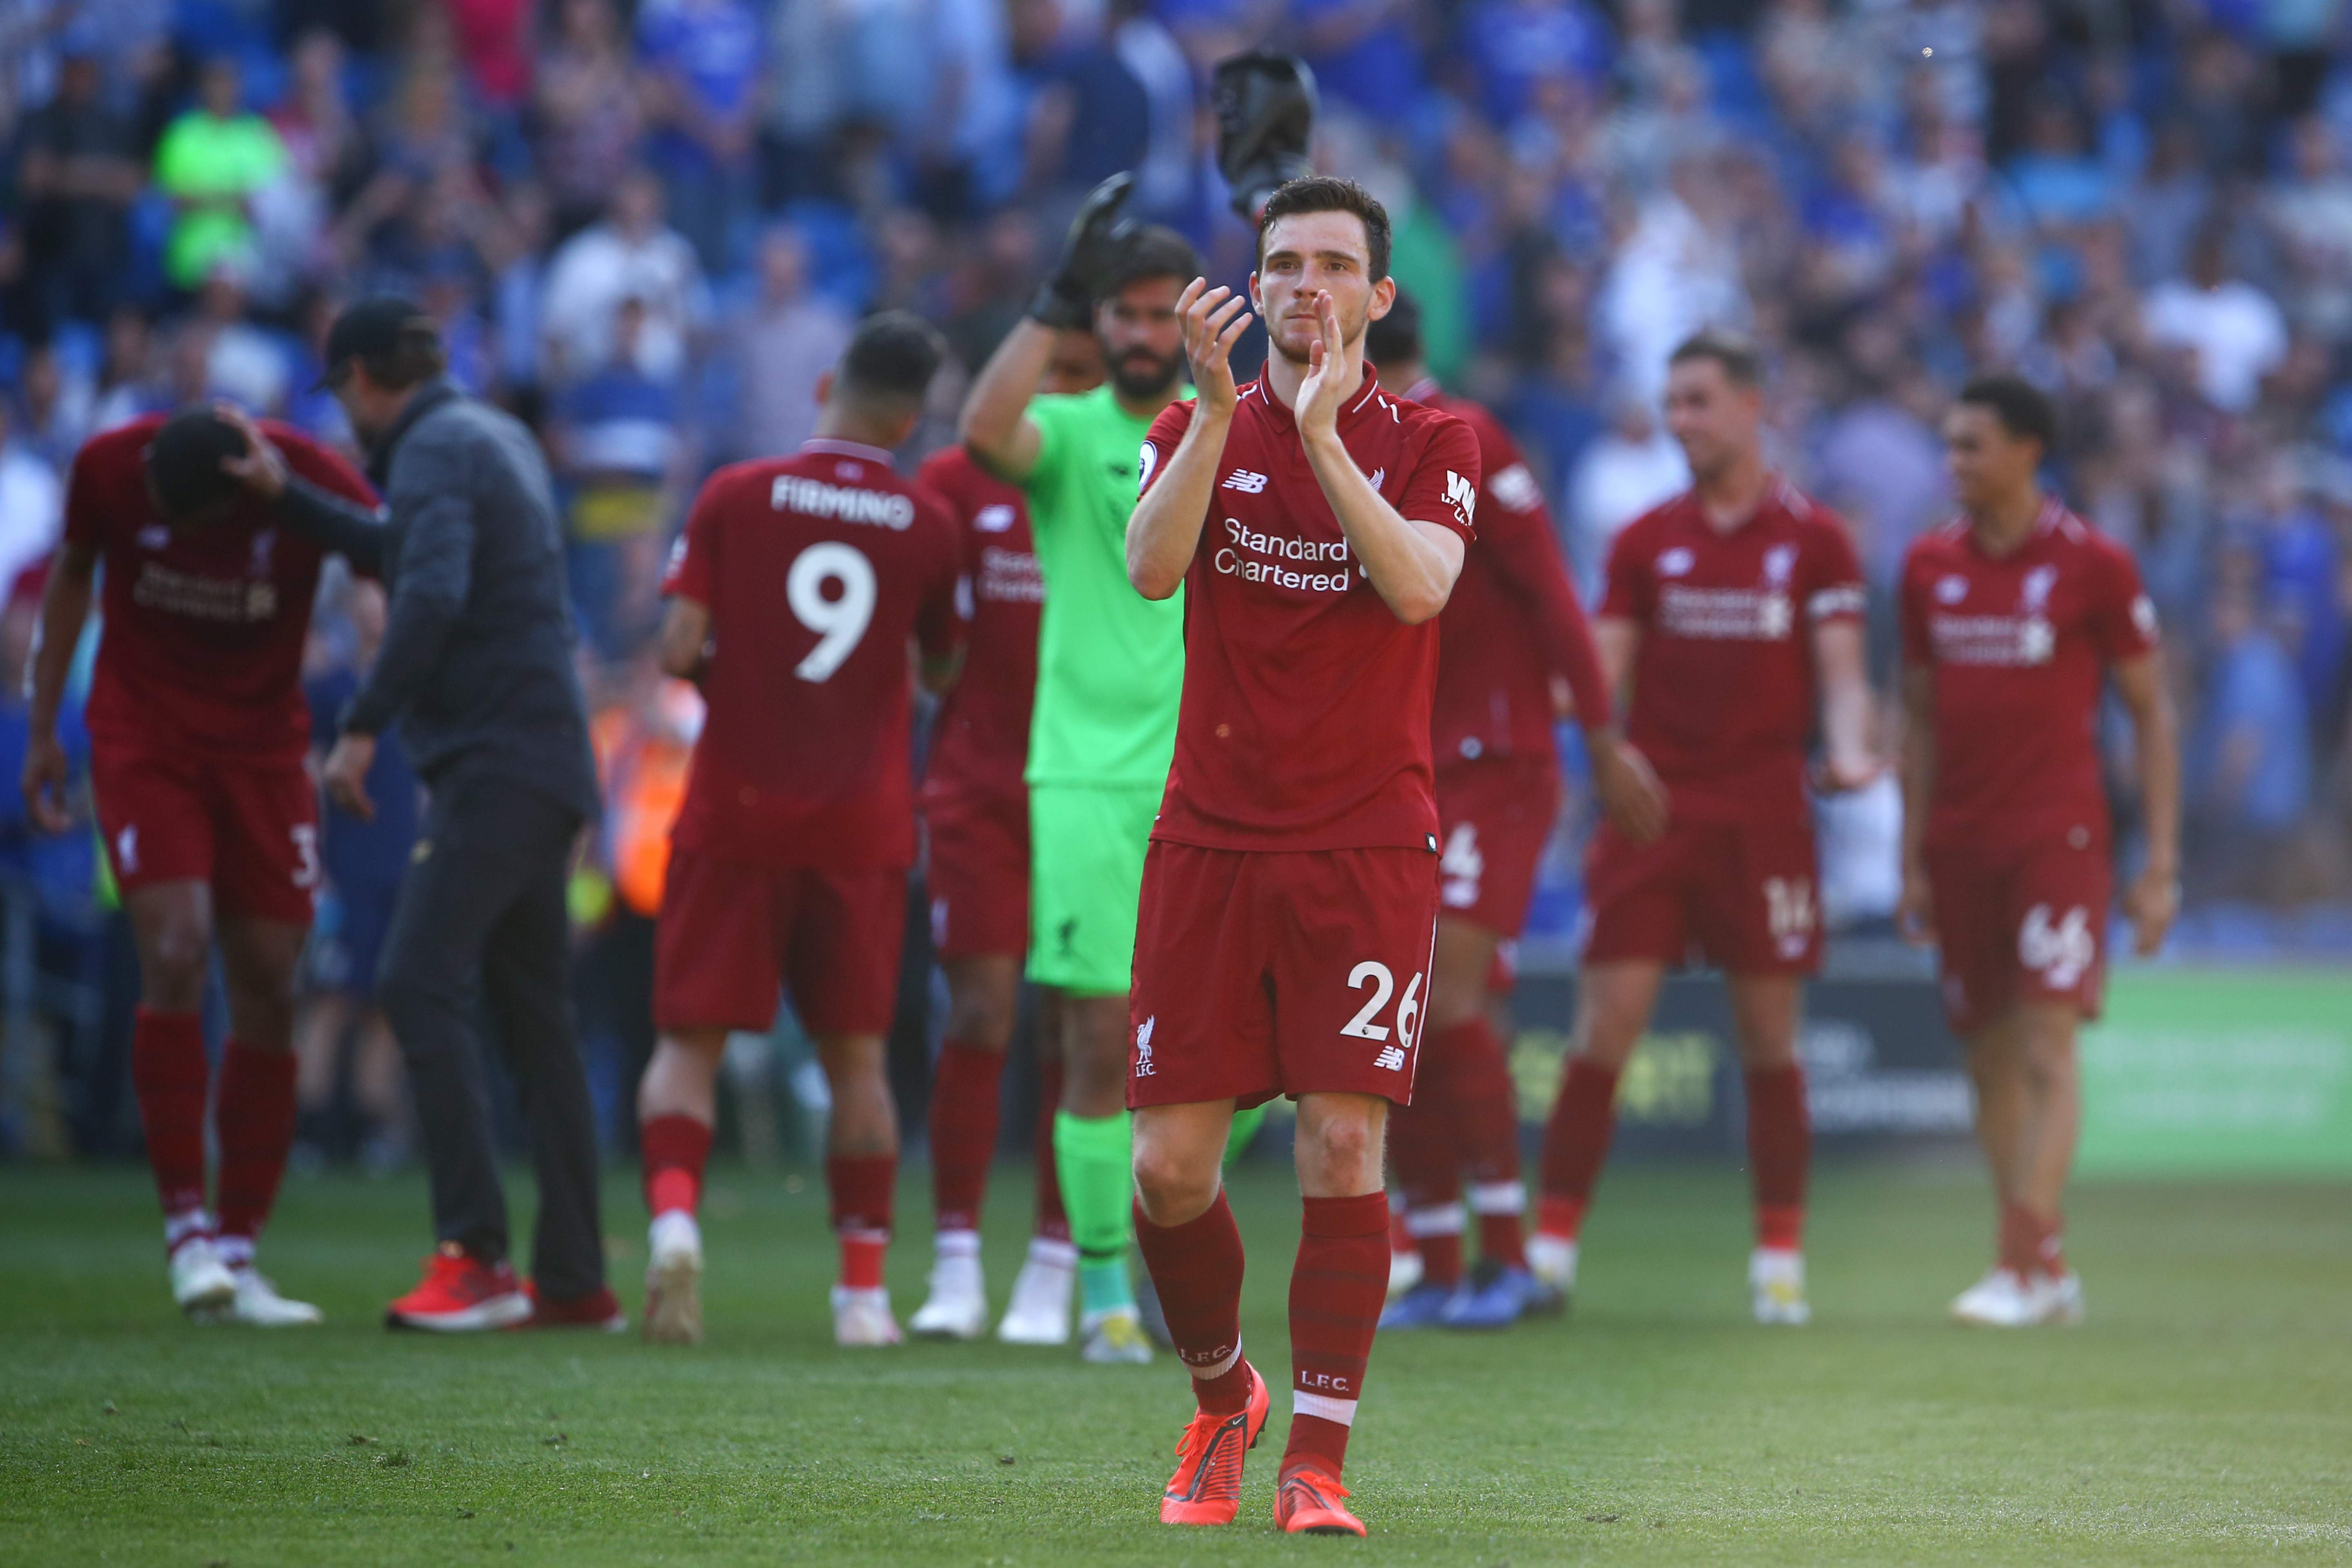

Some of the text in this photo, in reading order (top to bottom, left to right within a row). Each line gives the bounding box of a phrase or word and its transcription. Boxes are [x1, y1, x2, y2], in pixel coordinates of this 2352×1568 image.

[771, 474, 915, 531] FIRMINO
[1215, 548, 1349, 591] Chartered
[1225, 518, 1348, 561] Standard
[786, 540, 878, 684] 9
[290, 824, 320, 887] 3
[2018, 902, 2094, 971] 66
[1340, 961, 1423, 1048] 26
